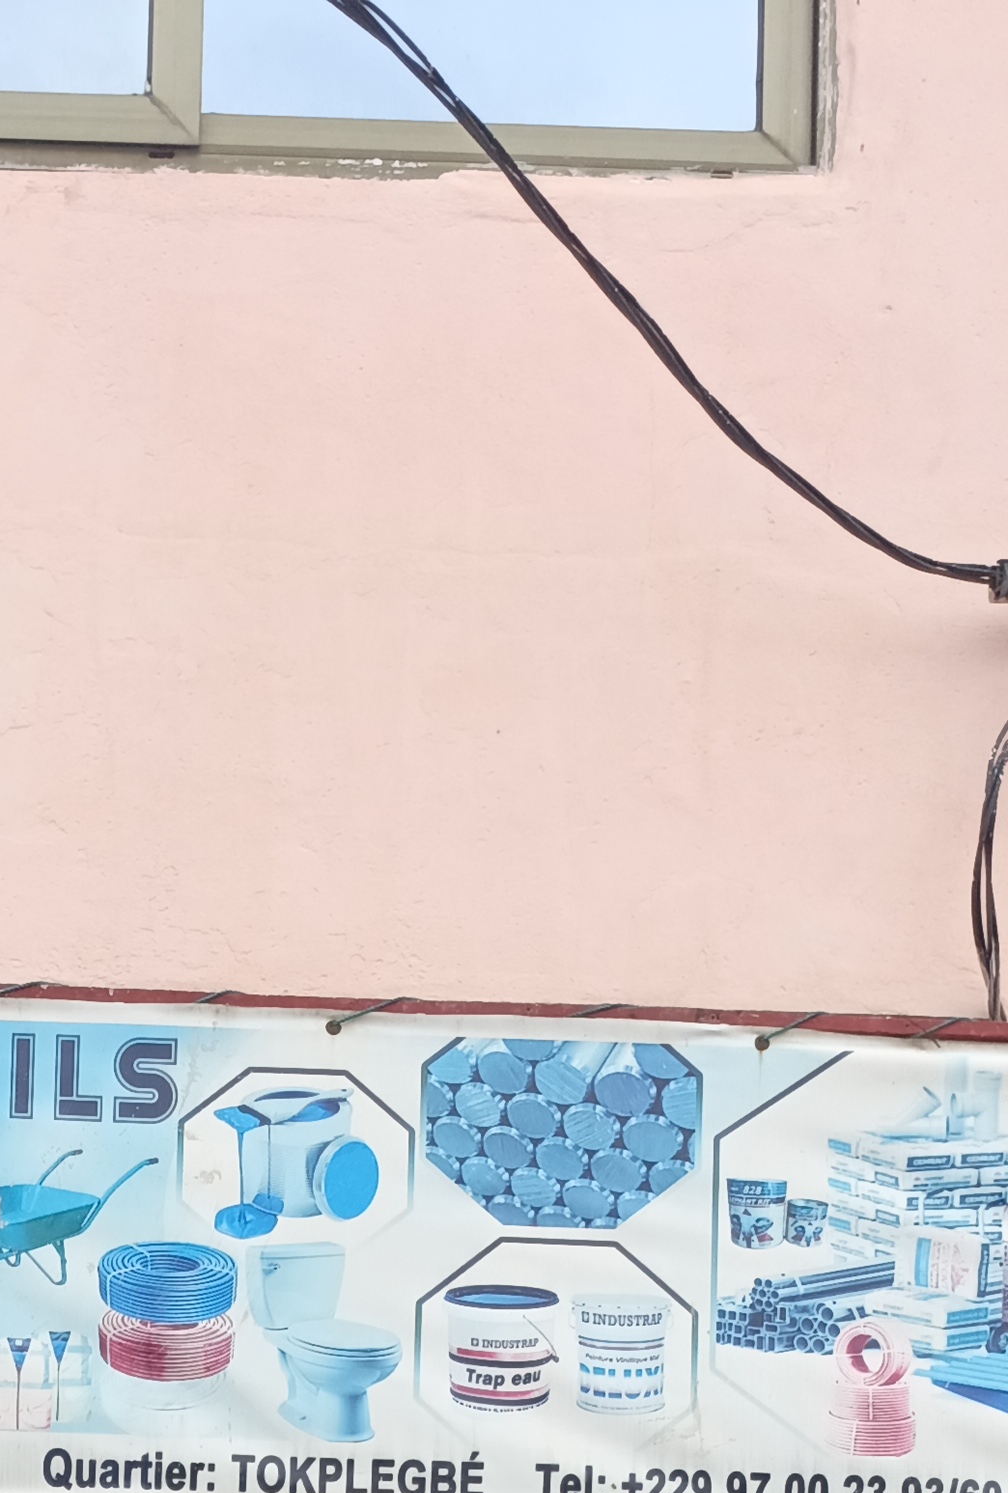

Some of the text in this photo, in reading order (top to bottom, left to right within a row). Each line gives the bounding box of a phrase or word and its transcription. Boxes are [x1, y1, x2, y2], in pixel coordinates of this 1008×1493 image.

[592, 1312, 663, 1327] INDUSTRAP
[482, 1338, 539, 1349] INDUSTRAP
[466, 1368, 541, 1389] Trap eau
[42, 1448, 216, 1492] Quartier:
